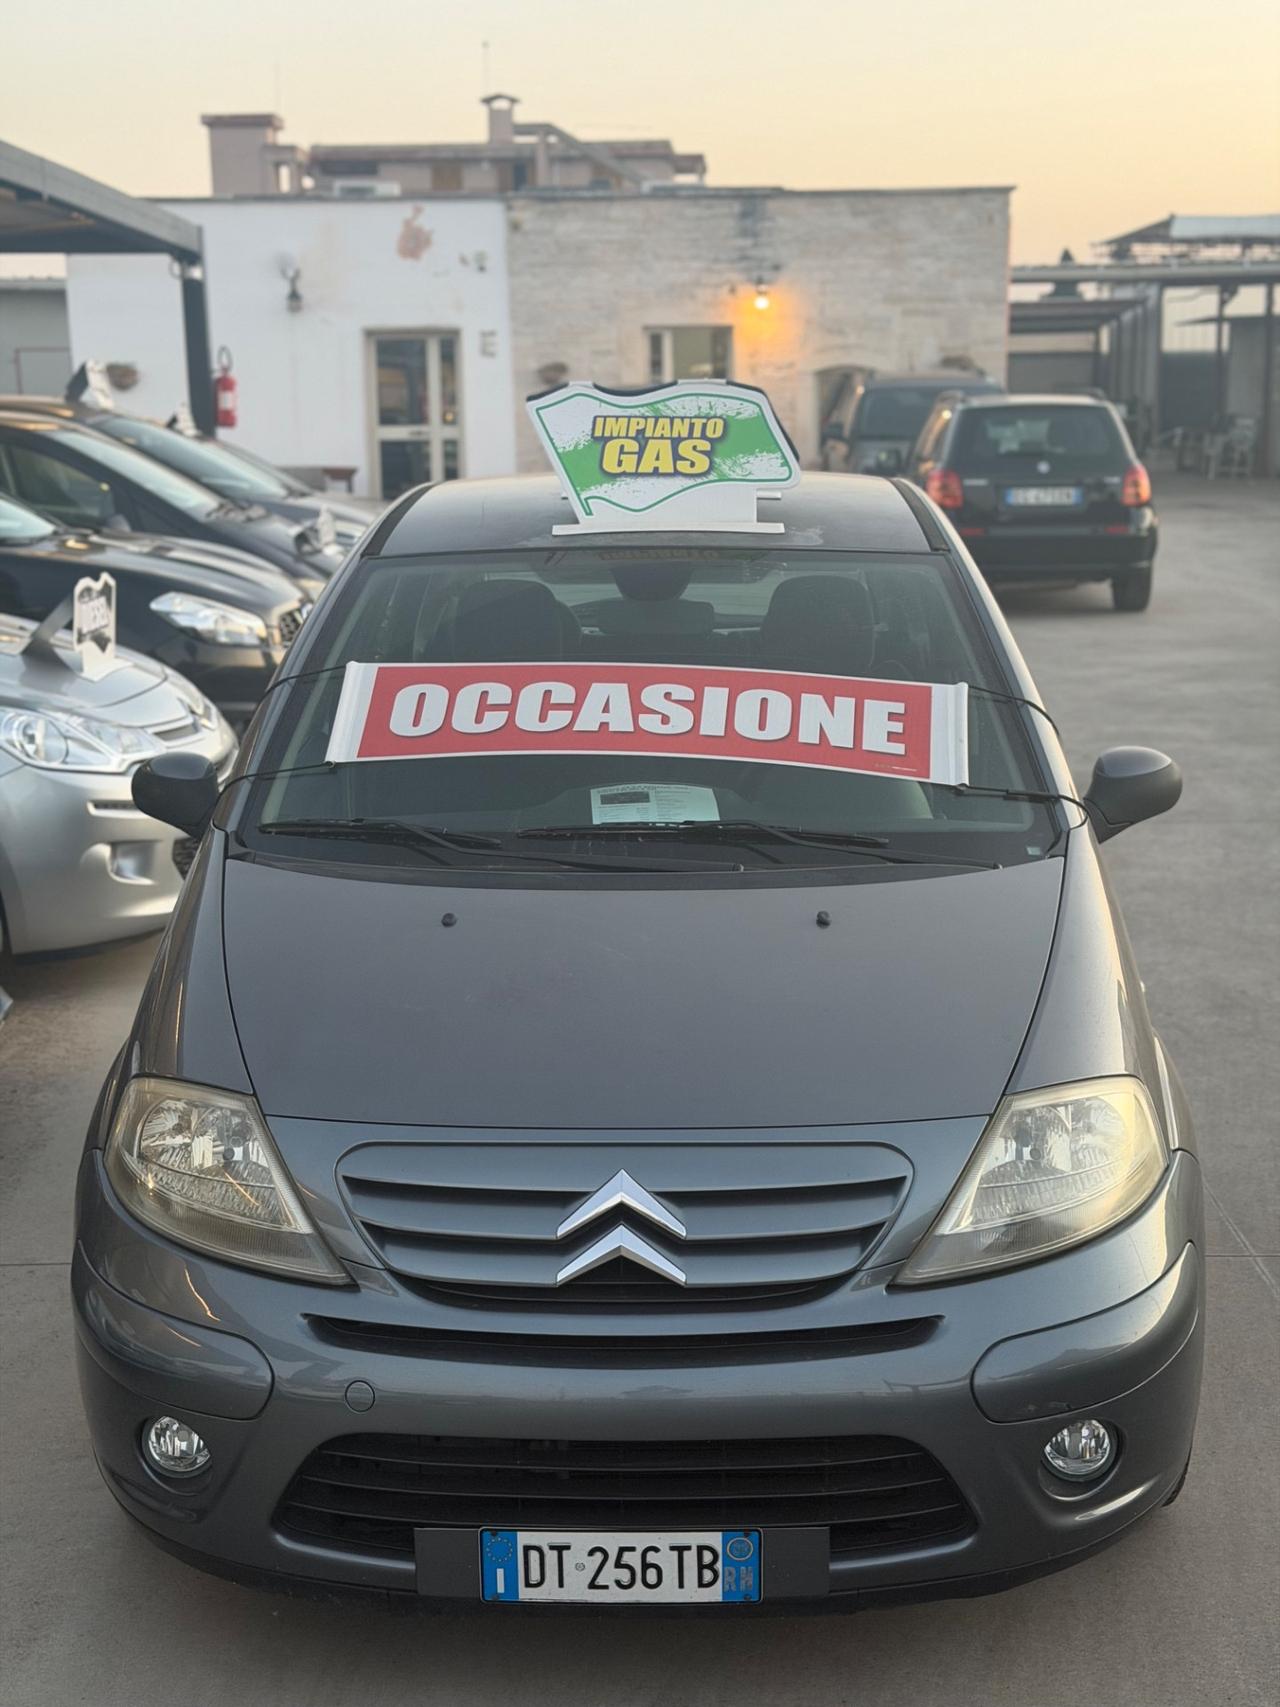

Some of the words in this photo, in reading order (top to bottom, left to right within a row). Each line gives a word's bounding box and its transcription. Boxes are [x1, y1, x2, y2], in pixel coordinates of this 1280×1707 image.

[592, 416, 726, 438] IMPIANTO
[601, 438, 712, 474] GAS
[389, 680, 906, 755] OCCASIONE
[522, 1543, 571, 1588] DT
